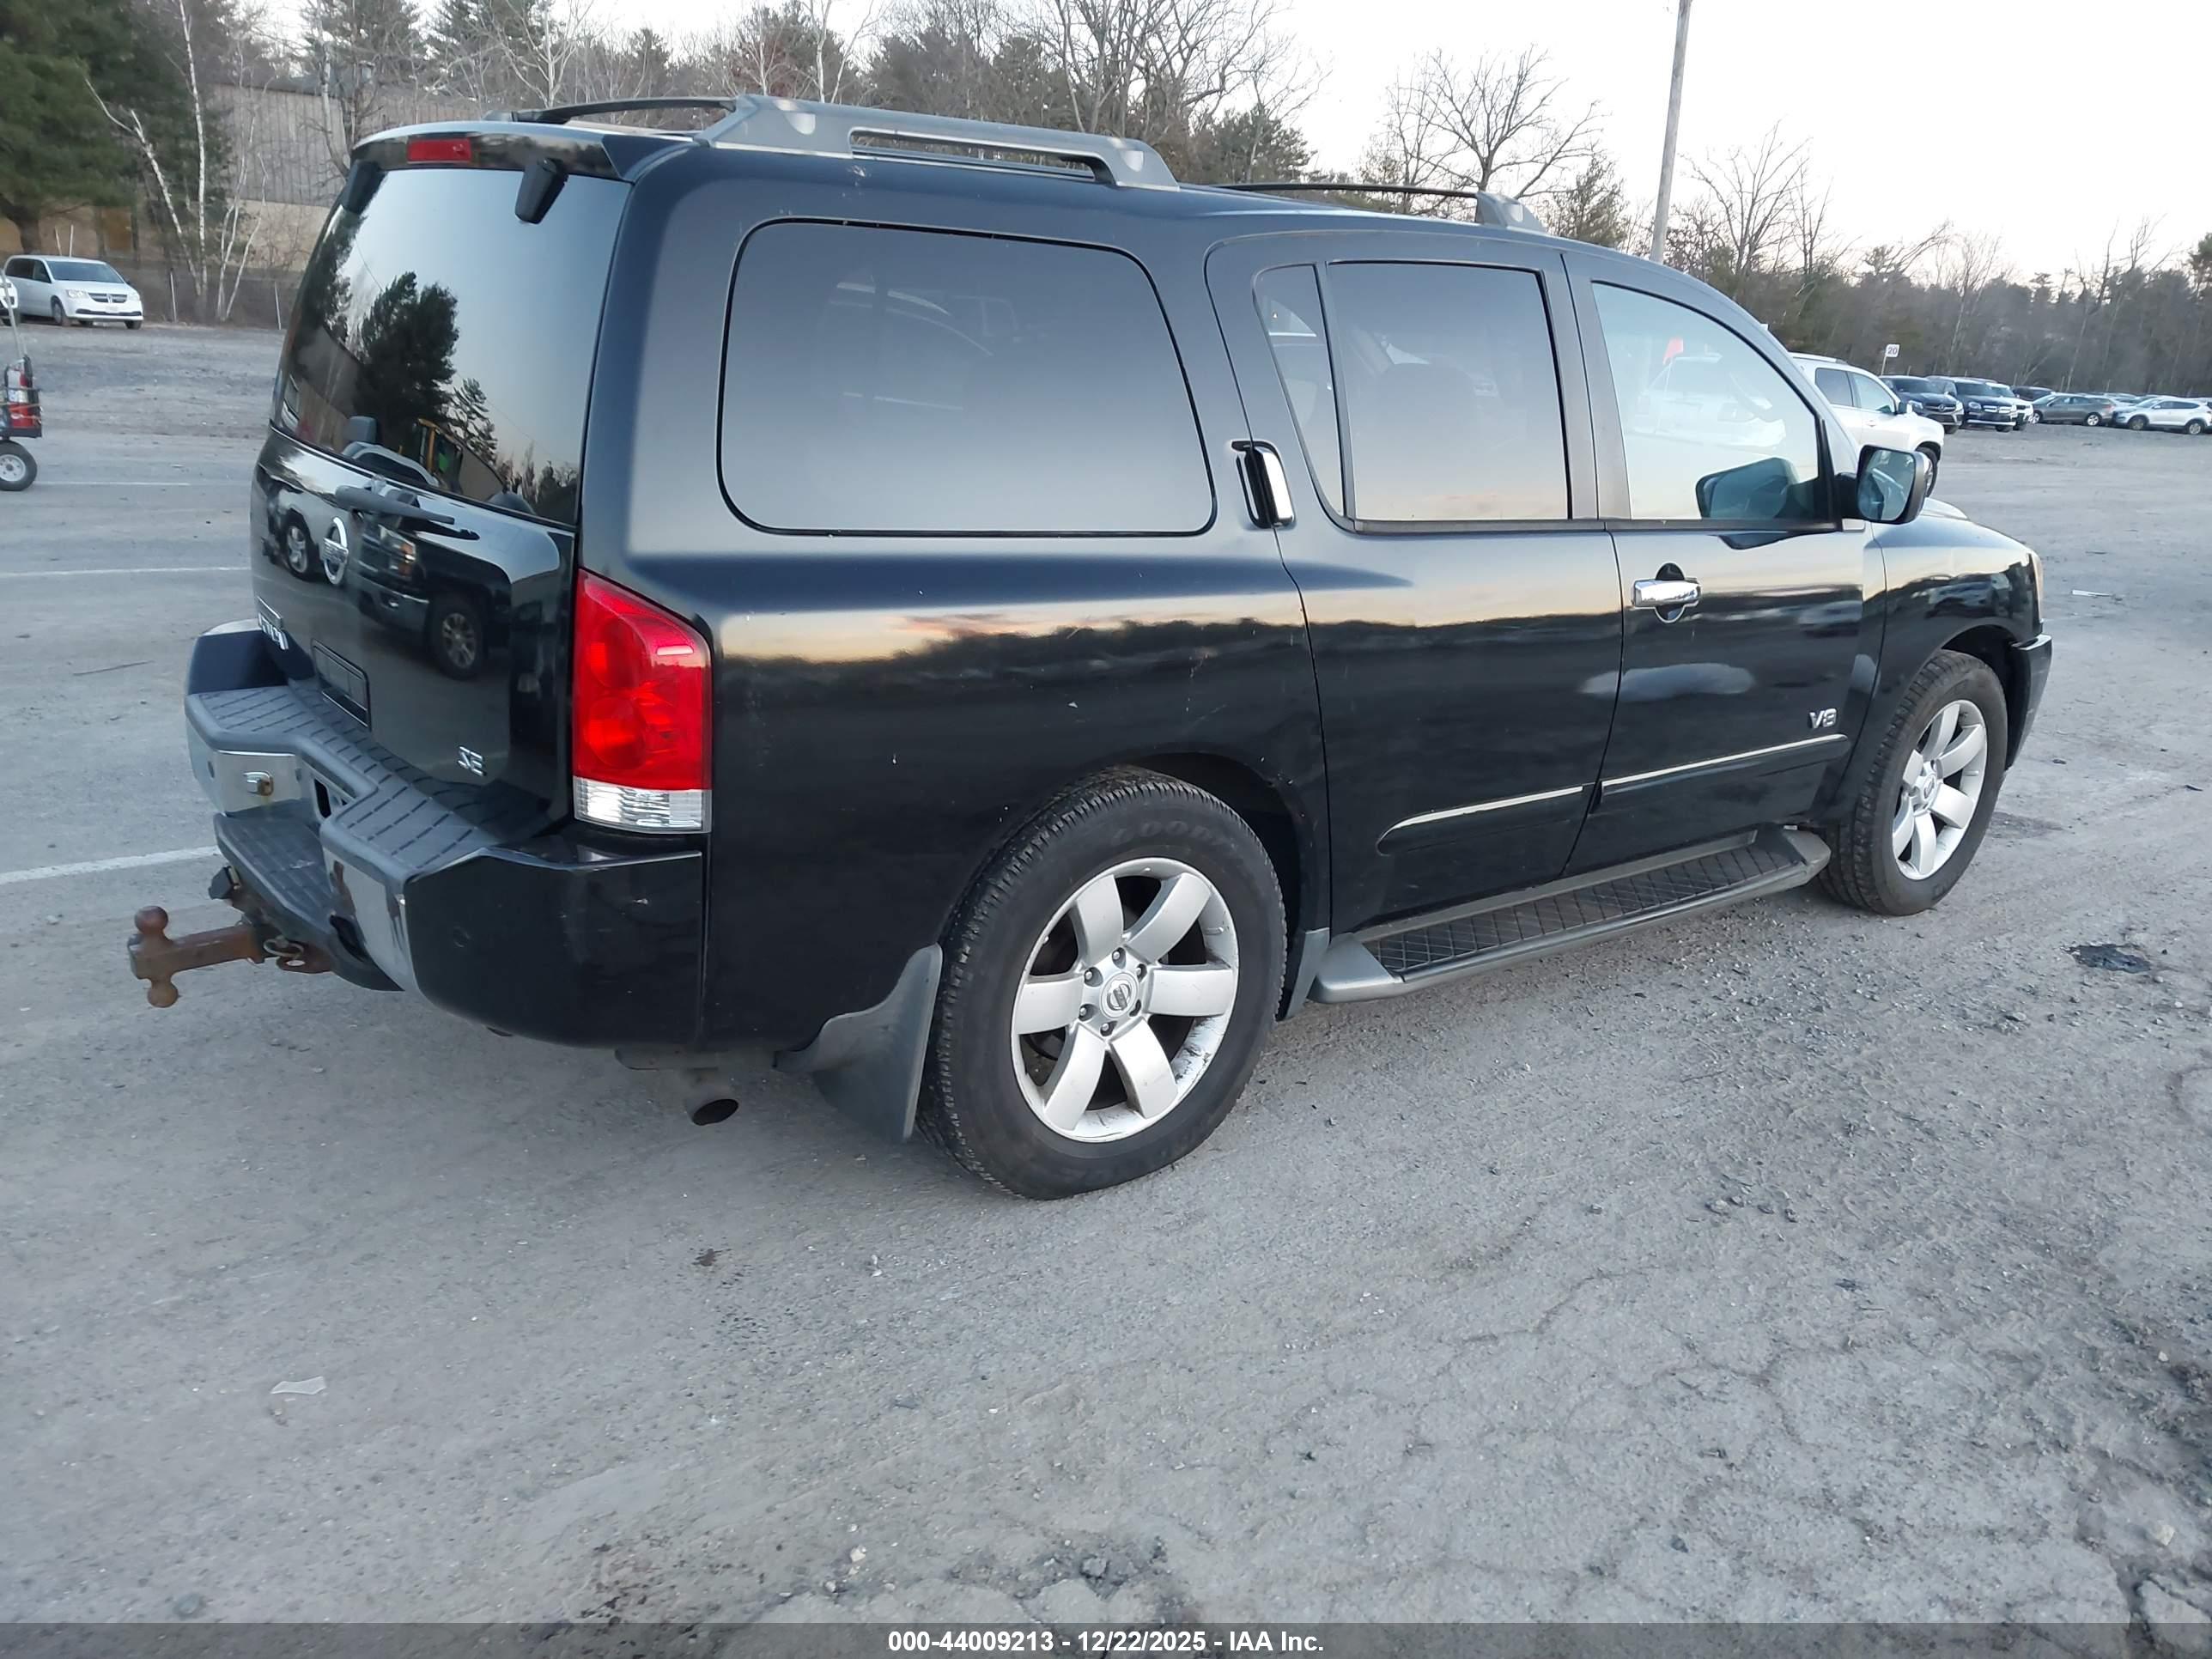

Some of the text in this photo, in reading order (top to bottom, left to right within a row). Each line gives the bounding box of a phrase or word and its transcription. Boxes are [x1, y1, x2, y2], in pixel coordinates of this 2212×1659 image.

[1887, 346, 1898, 356] 20
[1809, 708, 1838, 729] V8
[458, 746, 483, 776] SE
